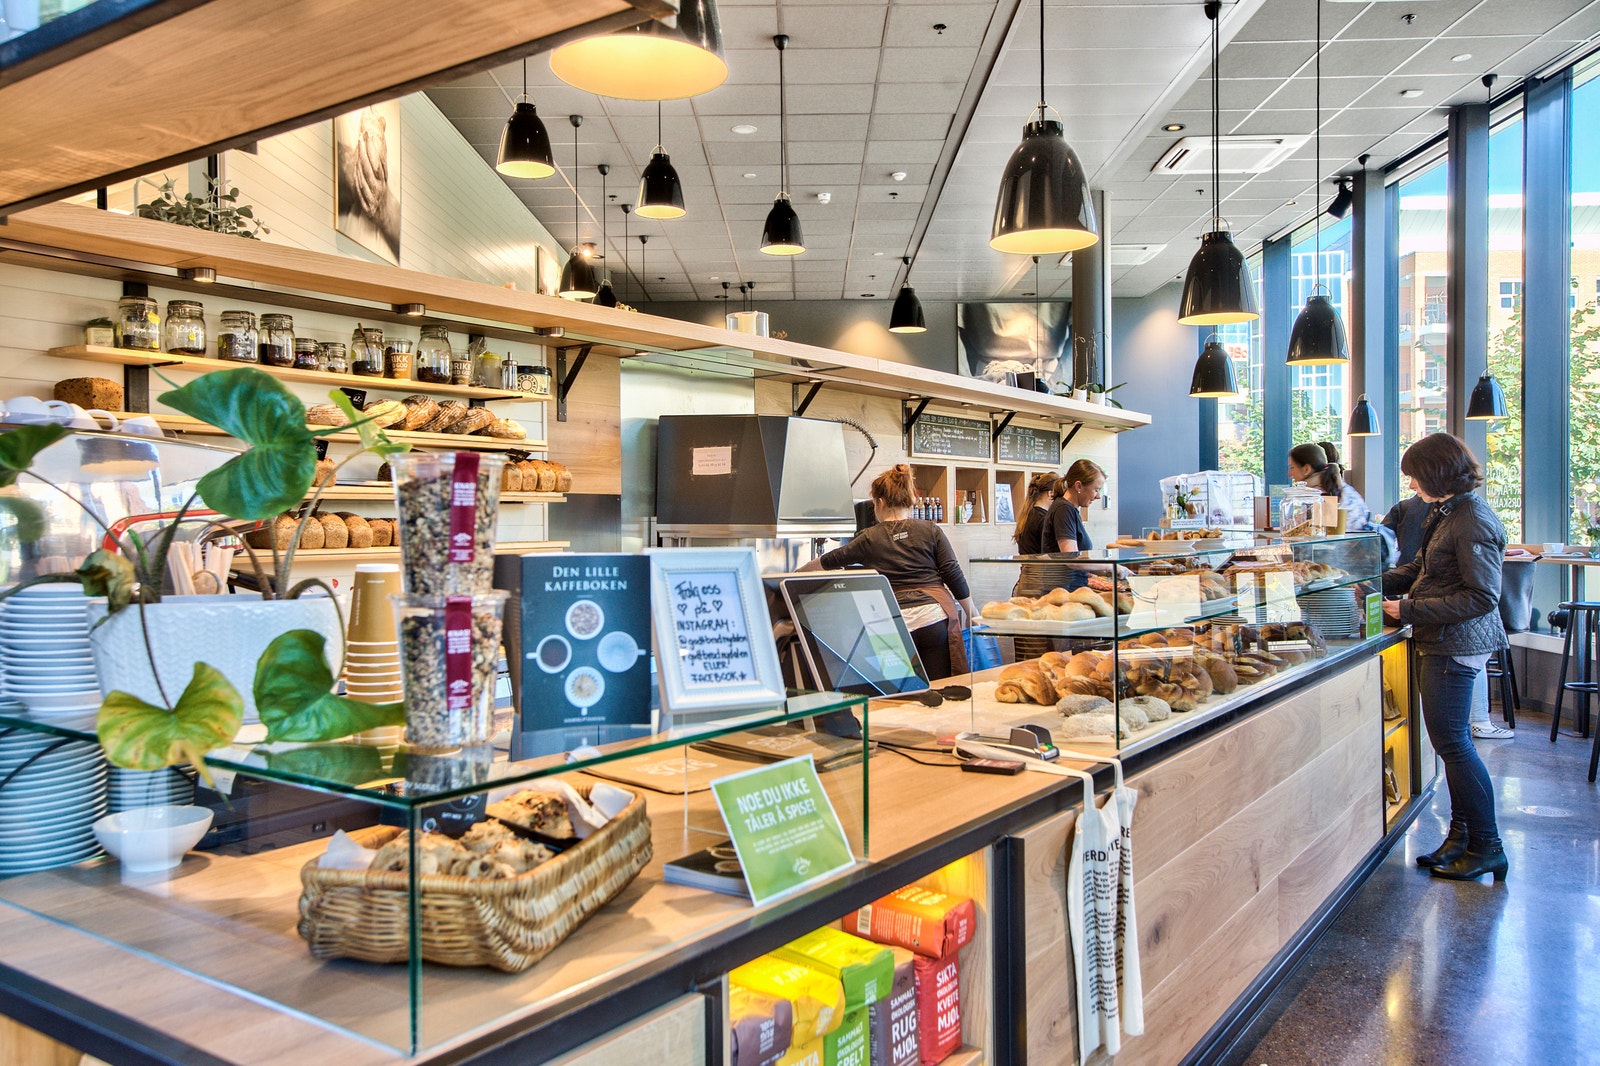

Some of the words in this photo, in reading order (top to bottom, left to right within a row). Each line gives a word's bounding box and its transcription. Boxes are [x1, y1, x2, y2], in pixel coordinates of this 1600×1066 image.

[552, 565, 582, 579] DEN
[585, 566, 620, 577] LILLE
[544, 580, 628, 592] KAFFEBOKEN
[736, 793, 764, 815] NOE
[763, 787, 783, 807] DU
[783, 777, 811, 801] IKKE
[744, 813, 777, 834] TÅLER
[777, 805, 787, 823] Å
[785, 798, 817, 820] SPISE?
[936, 962, 958, 987] SIKTA
[937, 990, 960, 1013] KVEITE
[892, 1010, 917, 1044] RUG
[937, 1006, 960, 1032] MJØL
[790, 1050, 819, 1066] KTA
[893, 1034, 918, 1065] MJØL
